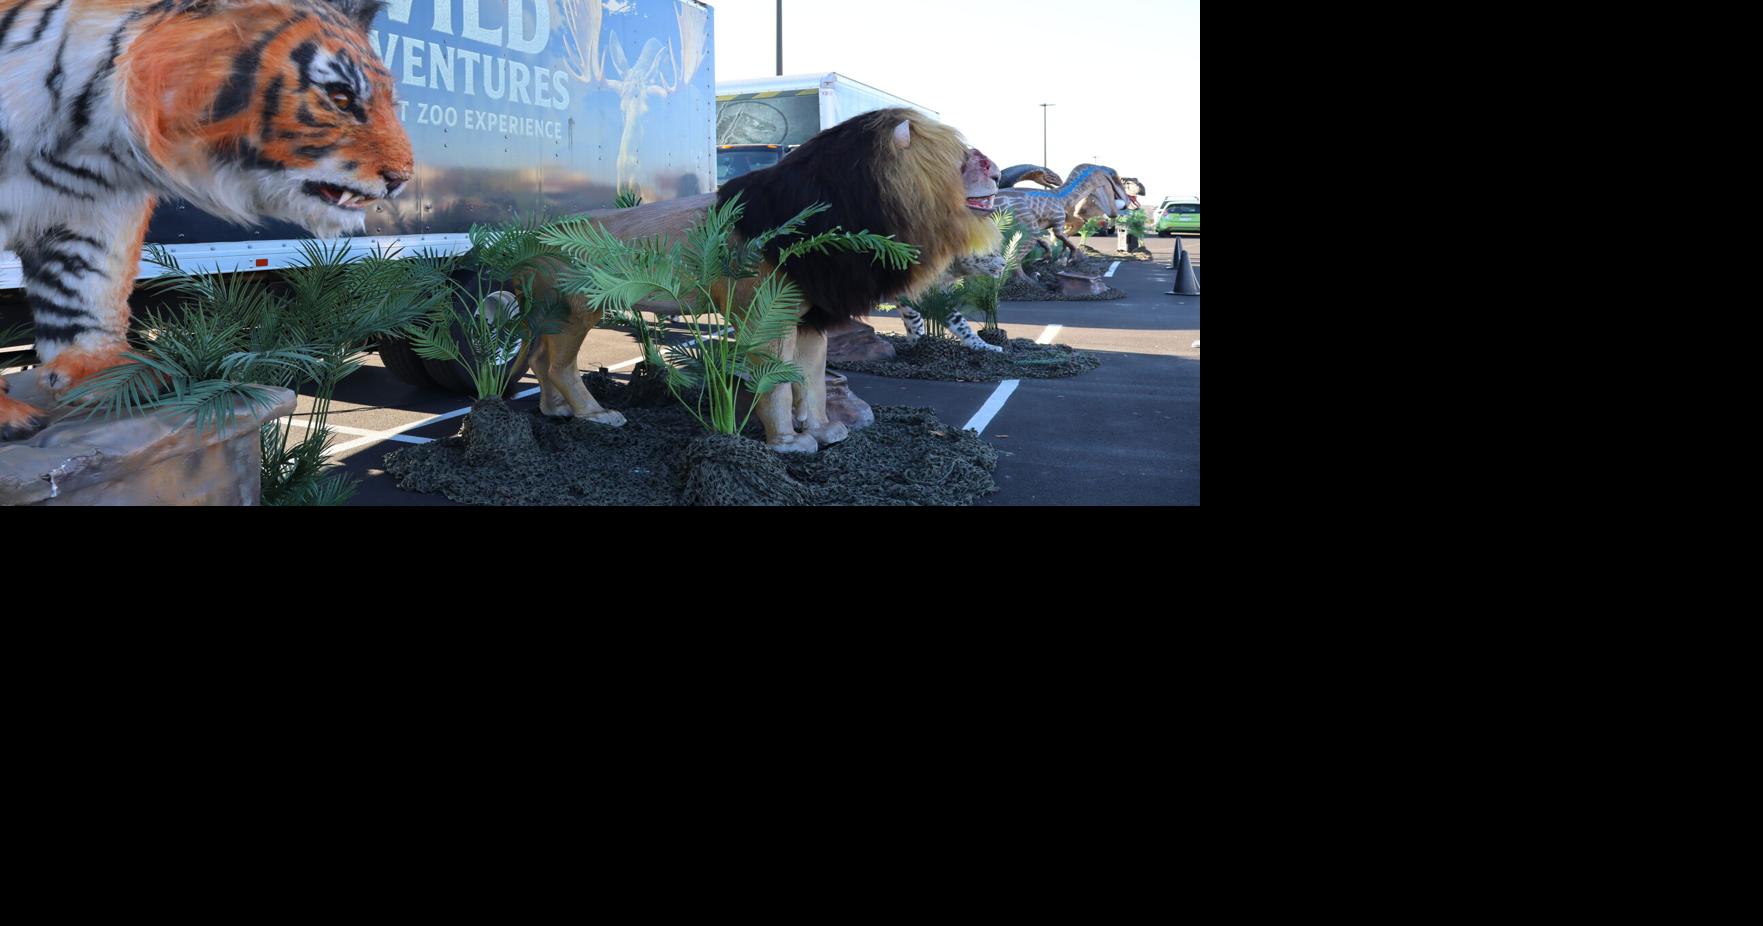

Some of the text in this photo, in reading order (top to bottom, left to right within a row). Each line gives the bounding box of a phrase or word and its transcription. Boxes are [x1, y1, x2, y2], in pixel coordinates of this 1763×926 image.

[370, 29, 570, 110] VENTURES
[416, 102, 457, 127] ZOO
[464, 109, 562, 139] EXPERIENCE
